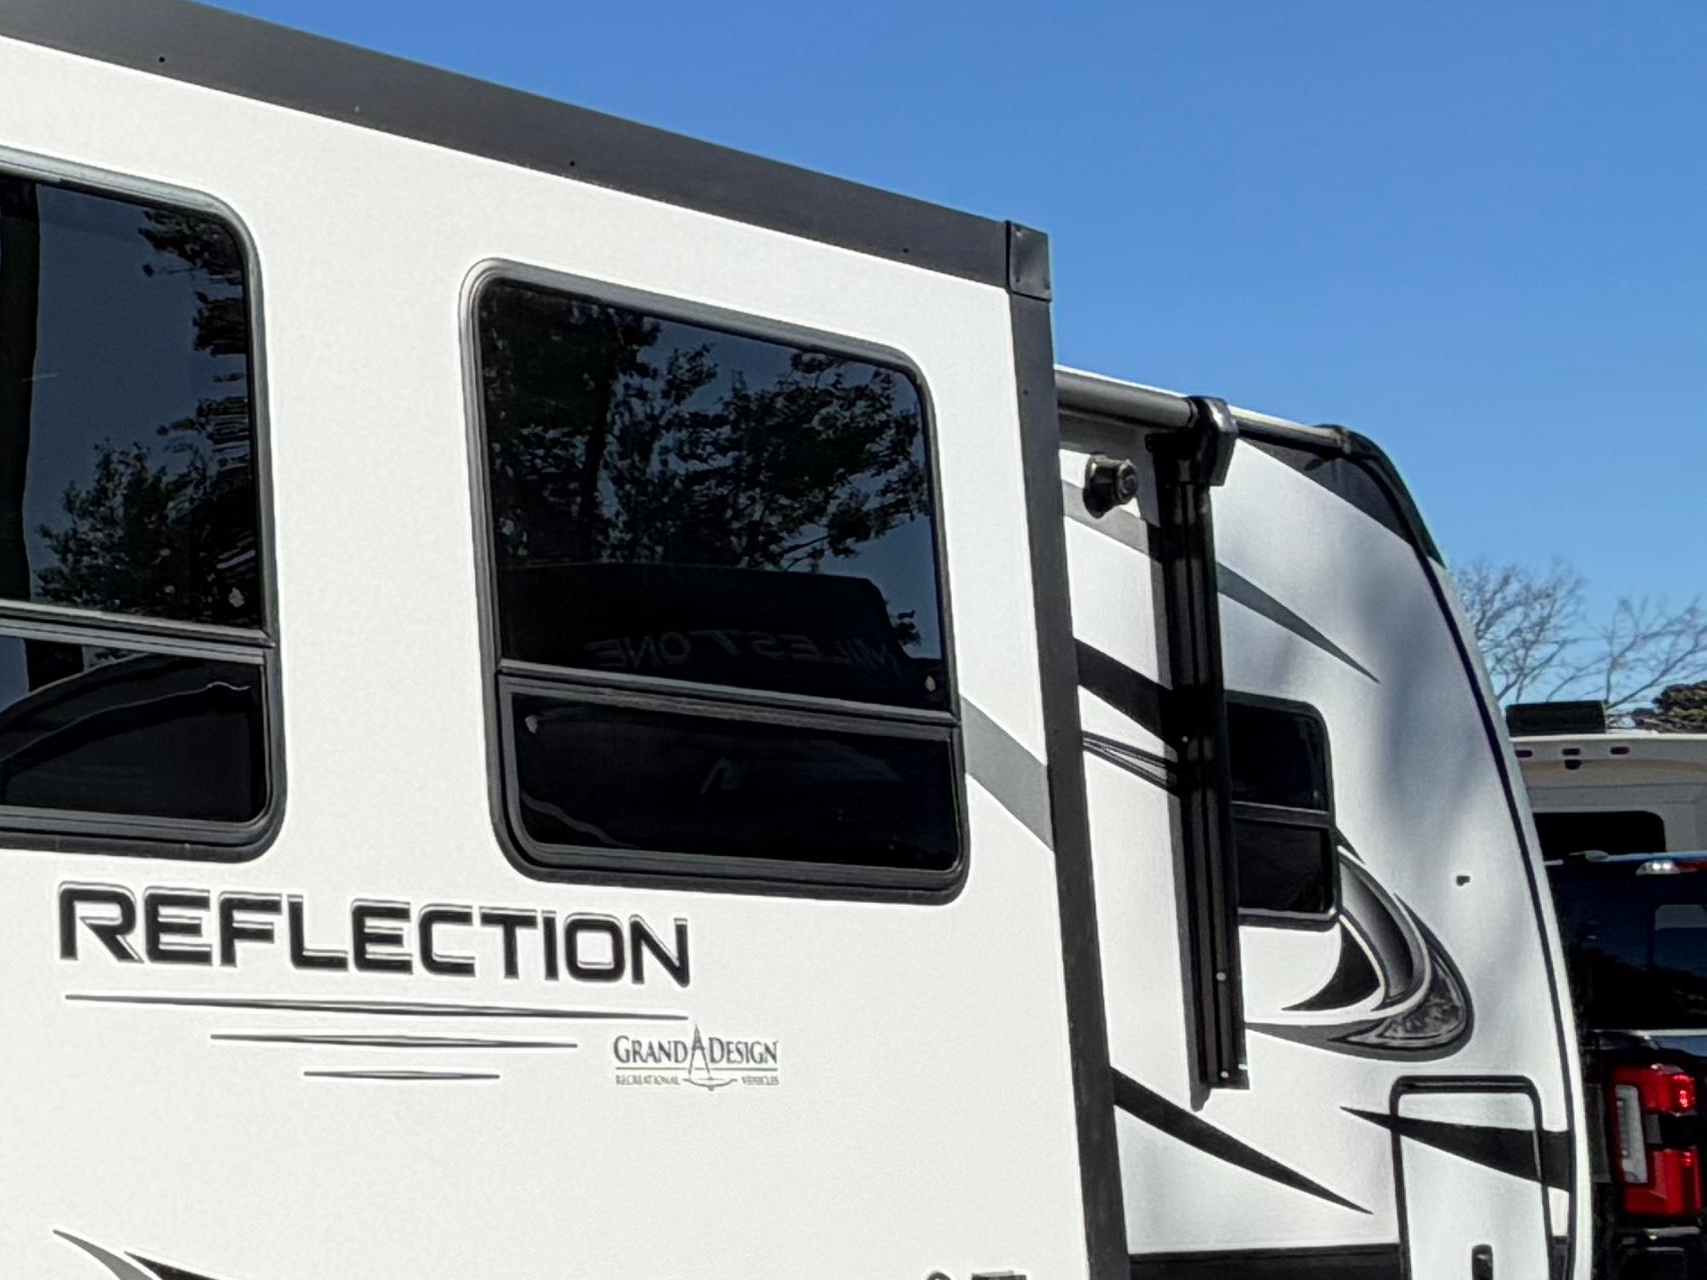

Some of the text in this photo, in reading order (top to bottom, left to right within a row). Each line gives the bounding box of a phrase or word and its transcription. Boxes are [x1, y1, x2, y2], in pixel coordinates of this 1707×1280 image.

[57, 880, 691, 988] REFLECTION
[613, 1035, 778, 1064] GRAND DESIGN
